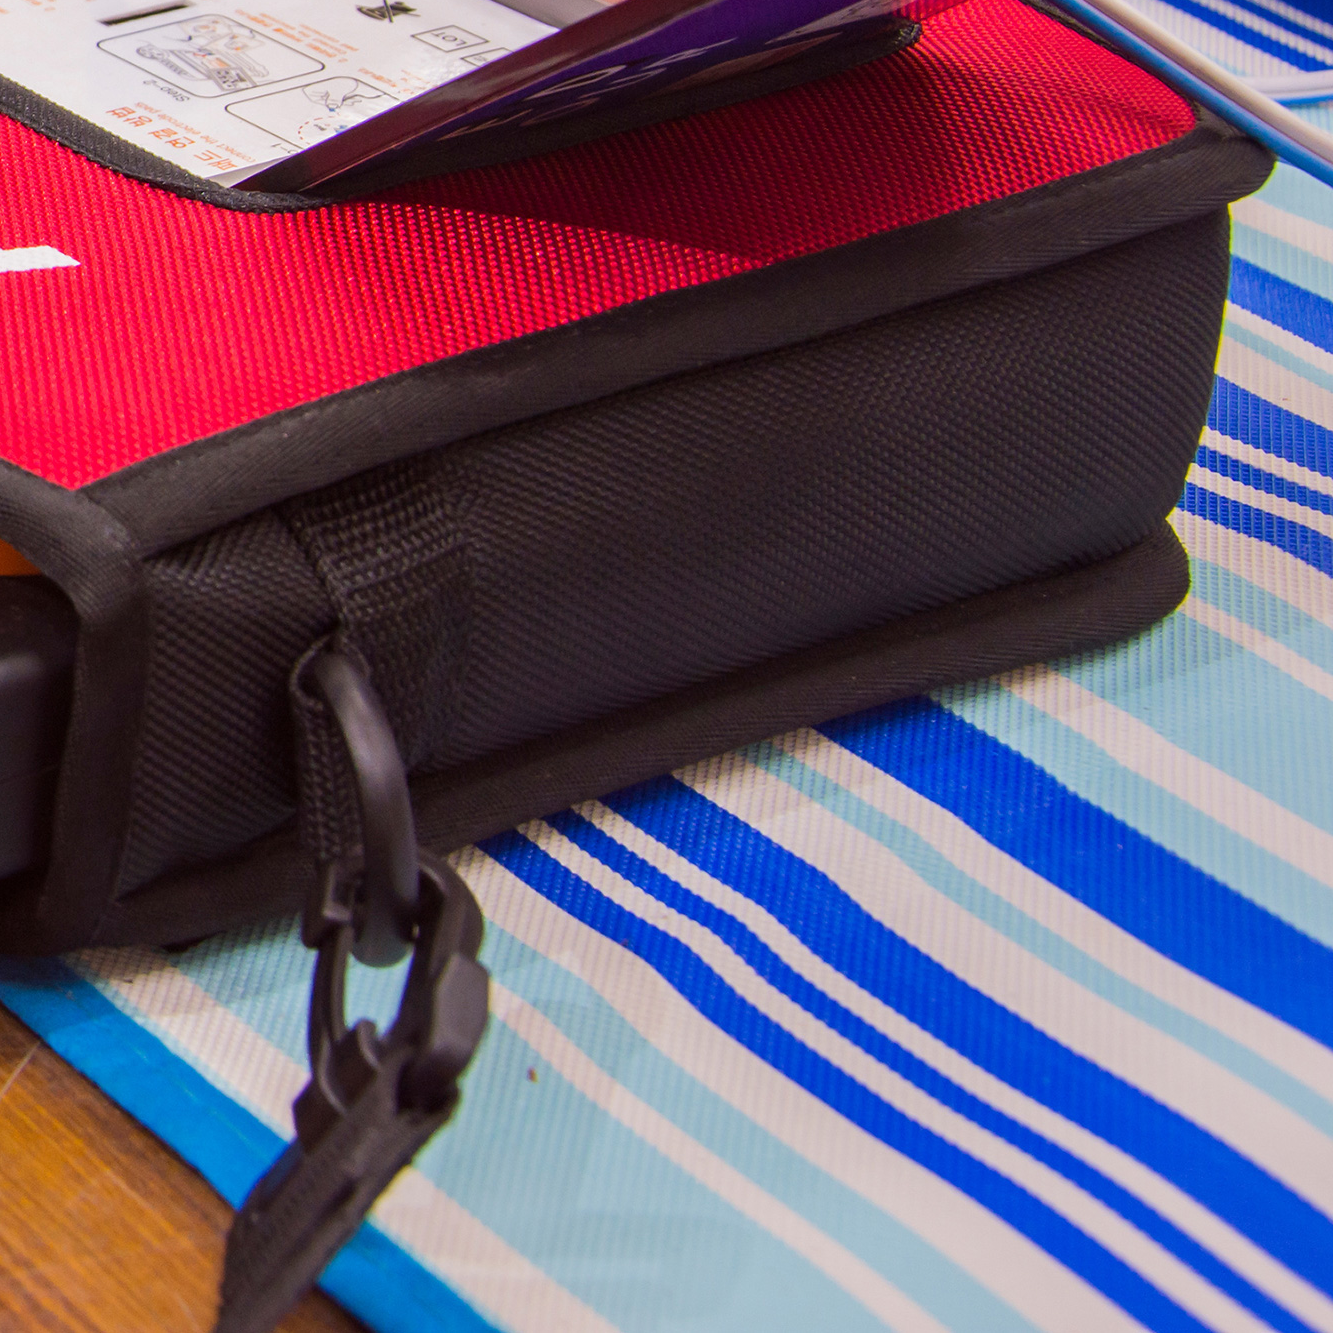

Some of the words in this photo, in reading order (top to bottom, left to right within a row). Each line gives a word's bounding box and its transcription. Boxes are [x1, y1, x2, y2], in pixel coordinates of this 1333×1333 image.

[431, 31, 467, 47] LOT
[143, 79, 190, 102] Step-2
[105, 106, 153, 127] 방법
[148, 127, 196, 149] 연결
[194, 150, 238, 171] 패드
[217, 143, 257, 163] connect
